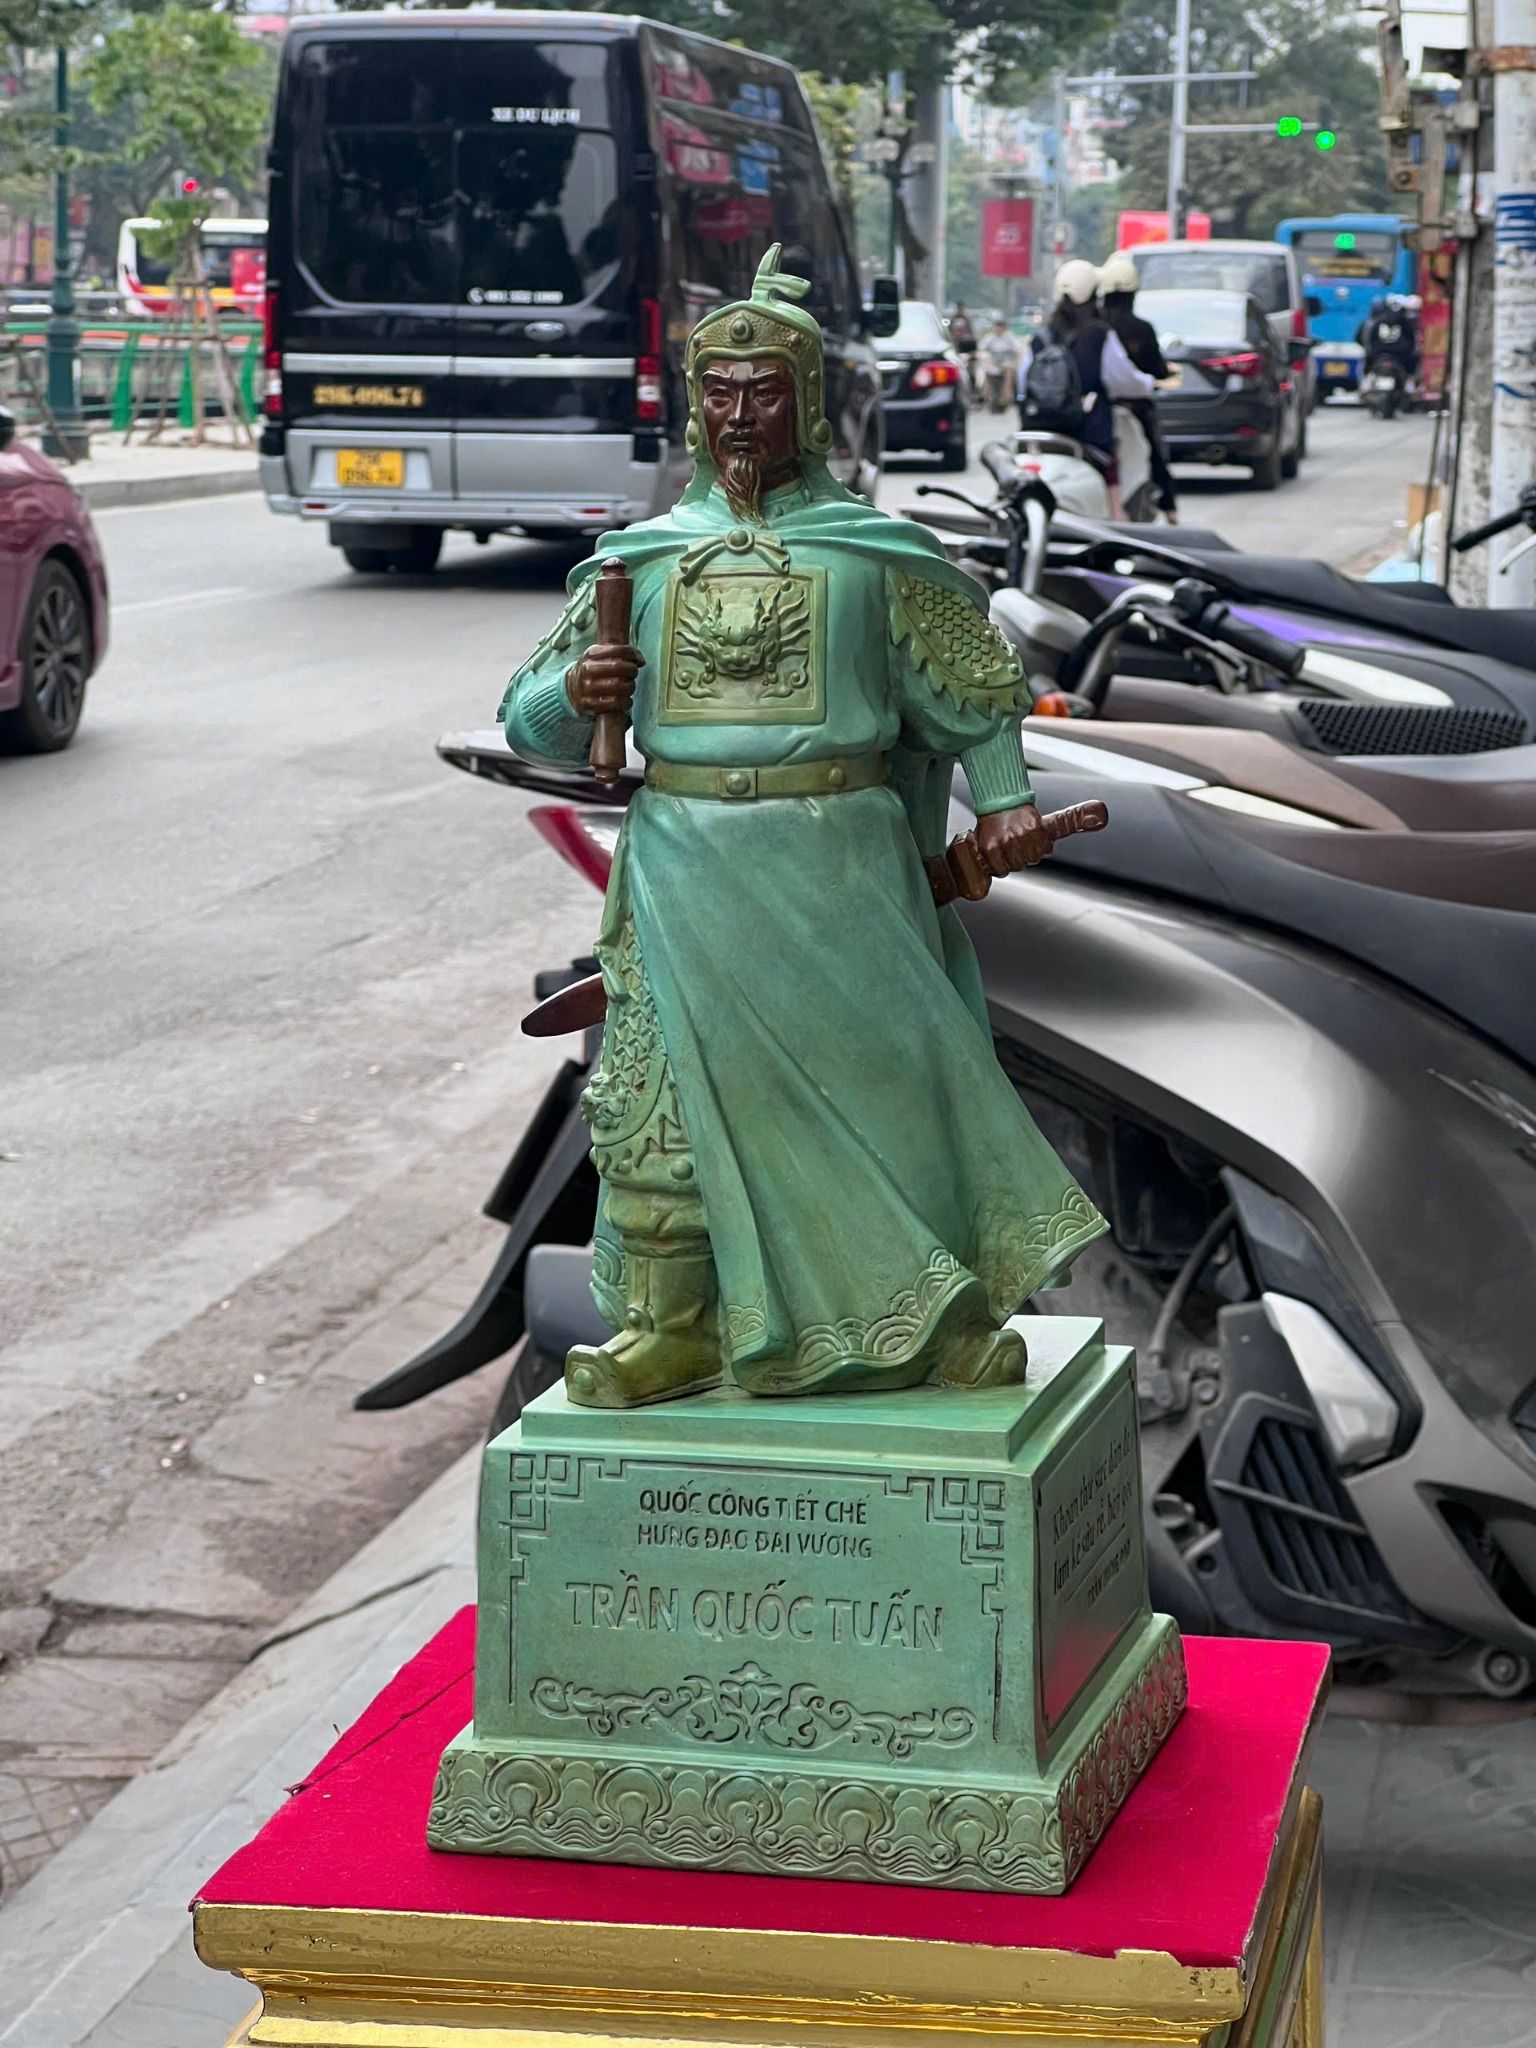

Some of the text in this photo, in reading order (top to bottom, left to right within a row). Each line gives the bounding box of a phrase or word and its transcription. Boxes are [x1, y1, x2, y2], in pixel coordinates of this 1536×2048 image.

[639, 1480, 870, 1525] QUỐC CÔNG TIẾT CHẾ
[1053, 1497, 1079, 1546] Khoan
[638, 1524, 700, 1549] HƯNG
[797, 1531, 872, 1559] VƯƠNG
[565, 1569, 944, 1652] TRẦN QUỐC TUẤN
